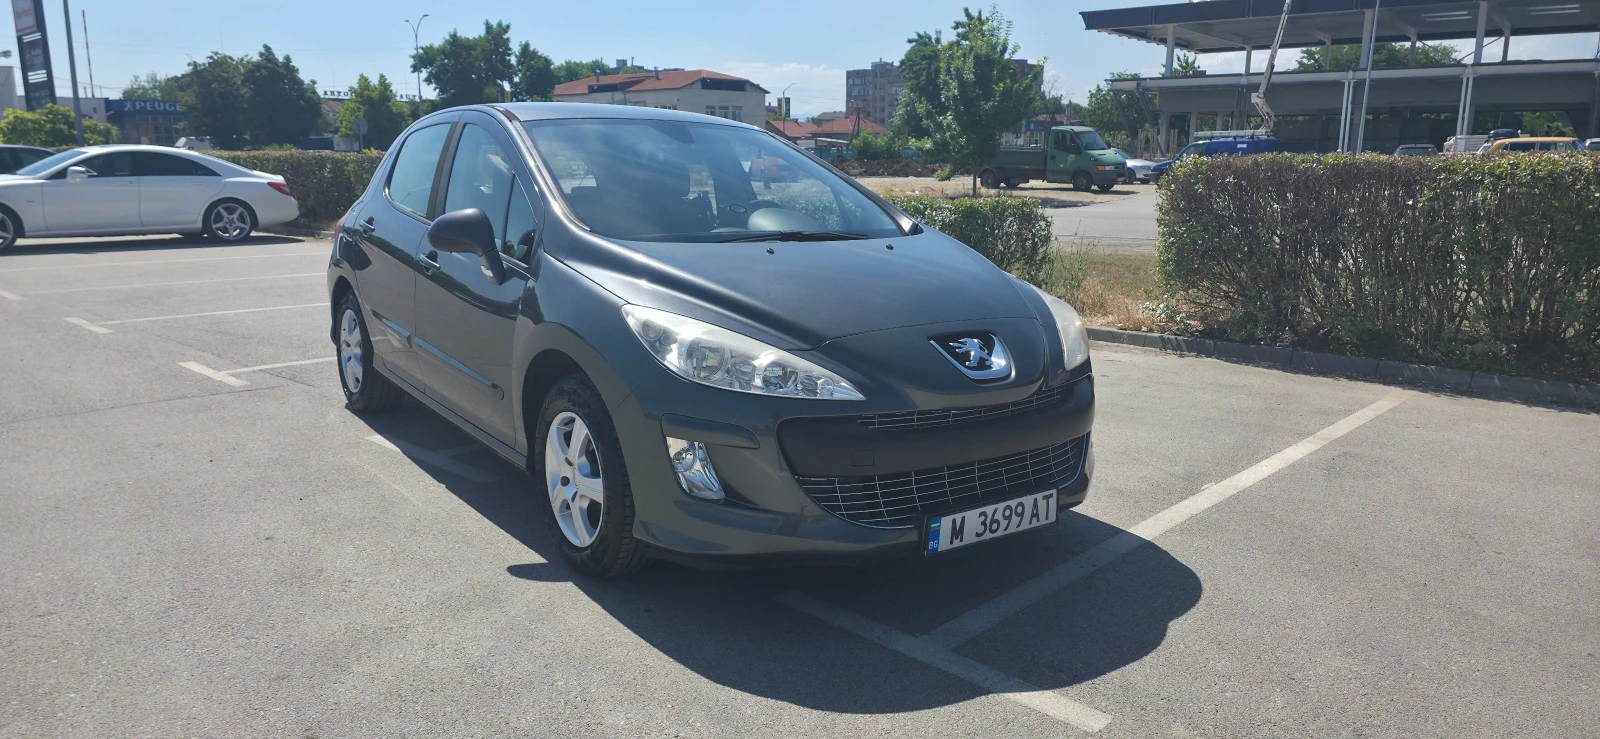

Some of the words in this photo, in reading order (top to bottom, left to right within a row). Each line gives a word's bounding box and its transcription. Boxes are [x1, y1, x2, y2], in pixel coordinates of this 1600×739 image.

[135, 101, 184, 111] PEUGE
[949, 515, 966, 545] M
[975, 501, 1026, 538] 3699
[1028, 492, 1054, 526] AT
[928, 540, 939, 550] BG
